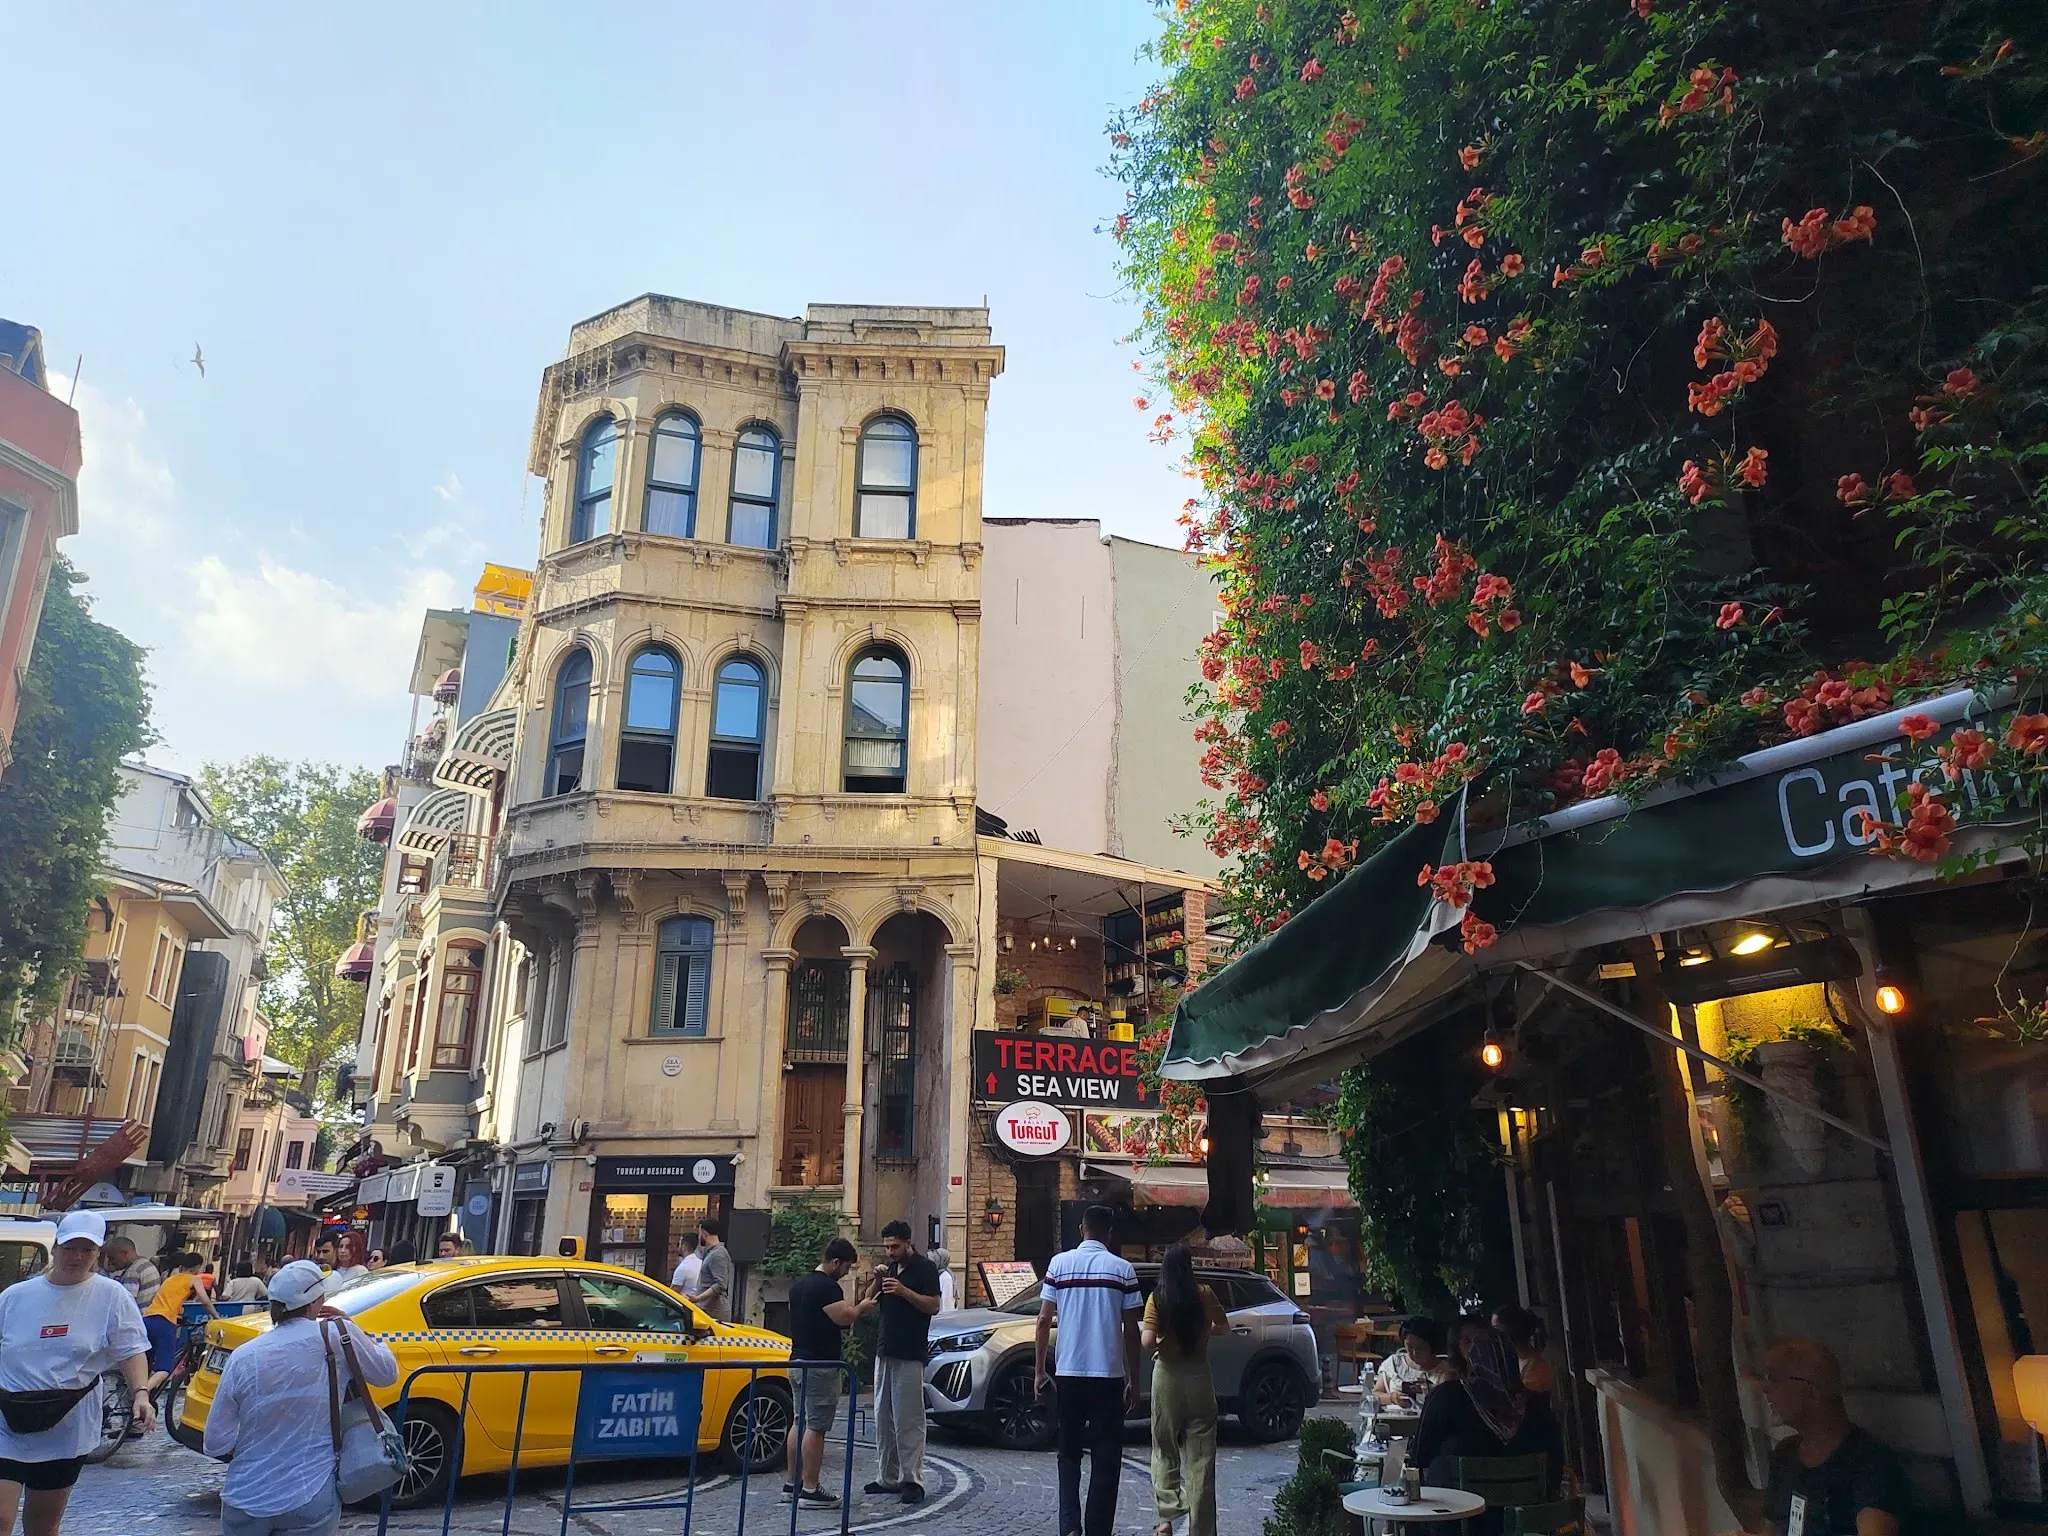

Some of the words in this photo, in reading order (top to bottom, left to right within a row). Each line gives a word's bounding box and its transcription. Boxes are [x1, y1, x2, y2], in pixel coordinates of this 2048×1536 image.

[994, 1038, 1138, 1077] TERRACE
[1017, 1074, 1062, 1098] SEA
[1066, 1077, 1120, 1101] VIEW
[616, 1167, 645, 1176] TURKISH
[647, 1167, 685, 1176] DESIGNERS
[612, 1388, 674, 1413] FATİH
[598, 1415, 679, 1438] ZABITA
